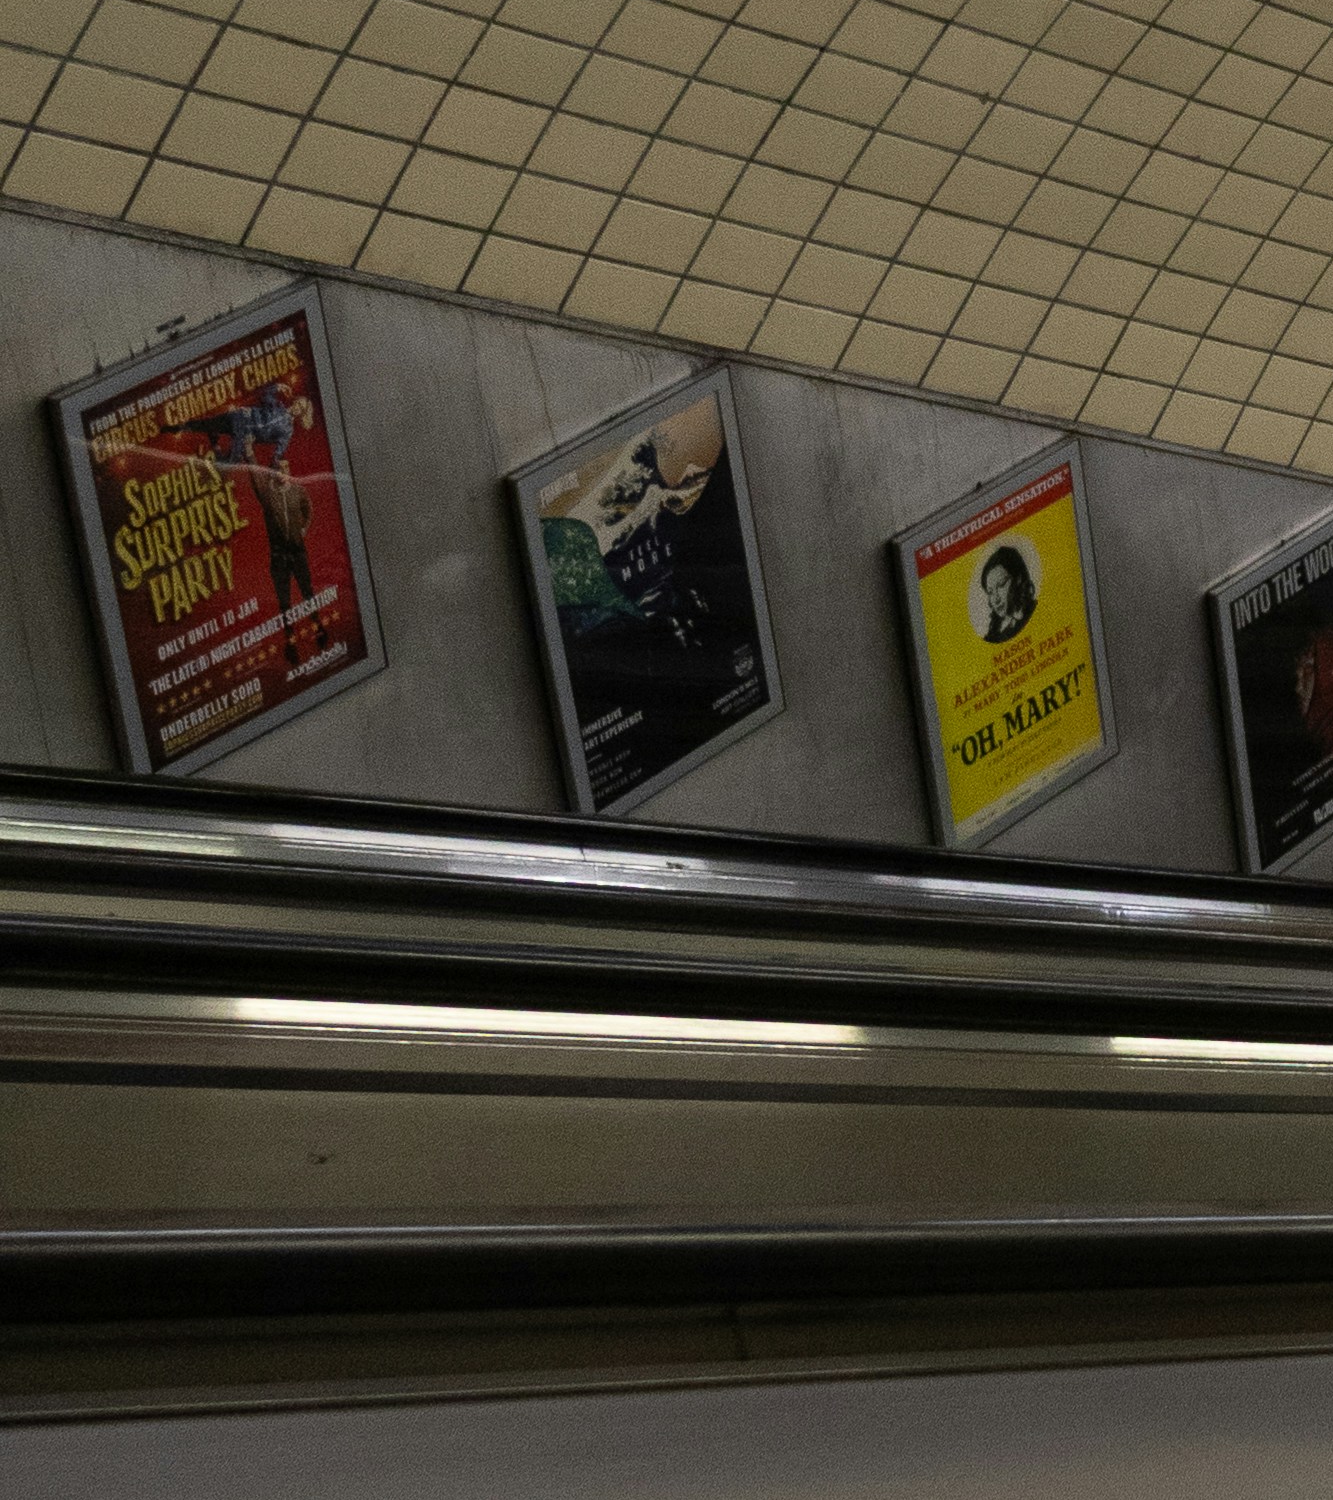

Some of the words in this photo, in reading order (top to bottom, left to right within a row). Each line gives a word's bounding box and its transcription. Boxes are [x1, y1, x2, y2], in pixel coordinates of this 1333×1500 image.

[90, 416, 116, 437] FROM
[118, 405, 138, 426] THE
[139, 381, 191, 416] PRODUCERS
[193, 374, 204, 388] OF
[205, 353, 250, 382] LONDON'S
[251, 344, 264, 359] LA
[123, 446, 223, 528] SOPHIE'S
[114, 480, 250, 590] SURPRISE
[622, 542, 672, 582] MORE
[629, 535, 660, 561] FEEL
[934, 507, 1004, 554] THEATRICAL
[148, 546, 235, 623] PARTY
[1234, 583, 1272, 630] INTO
[1272, 561, 1304, 604] THE
[157, 635, 187, 661] ONLY
[188, 618, 221, 645] UNTIL
[238, 597, 260, 619] JAN
[210, 637, 242, 664] NIGHT
[242, 613, 285, 648] CABARET
[160, 691, 231, 742] UNDERBELLY
[231, 676, 262, 705] SOHO
[954, 650, 1036, 708] ALEXANDER
